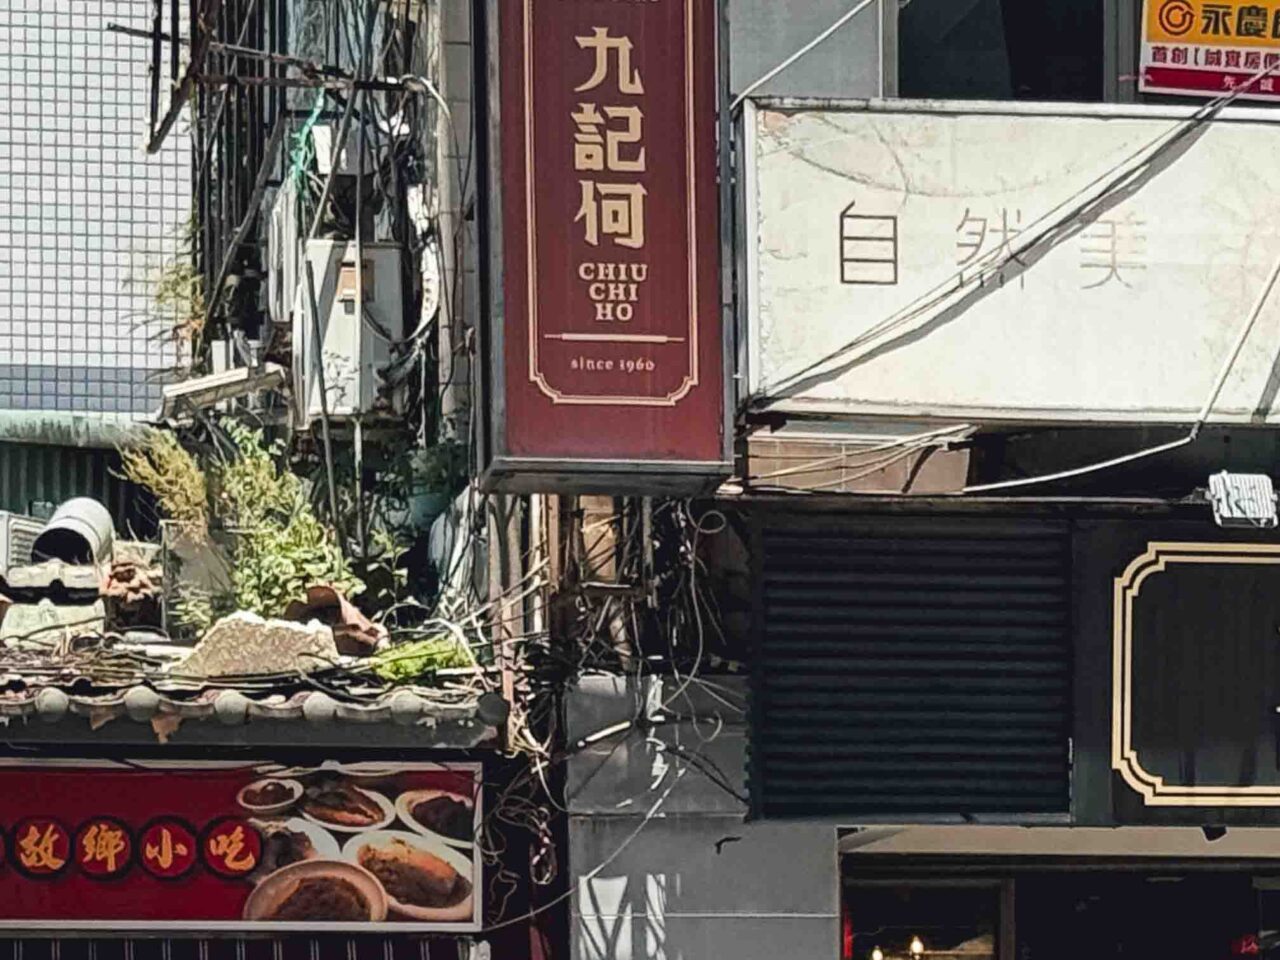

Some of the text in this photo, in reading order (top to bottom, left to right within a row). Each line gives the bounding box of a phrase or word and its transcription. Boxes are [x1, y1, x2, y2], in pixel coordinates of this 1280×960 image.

[571, 26, 649, 248] 九記何
[839, 200, 1147, 290] 自然美
[578, 263, 648, 281] CHIU
[589, 282, 639, 300] CHI
[595, 303, 634, 320] HO
[570, 356, 656, 373] since 1960
[19, 824, 256, 873] 故鄉小吃
